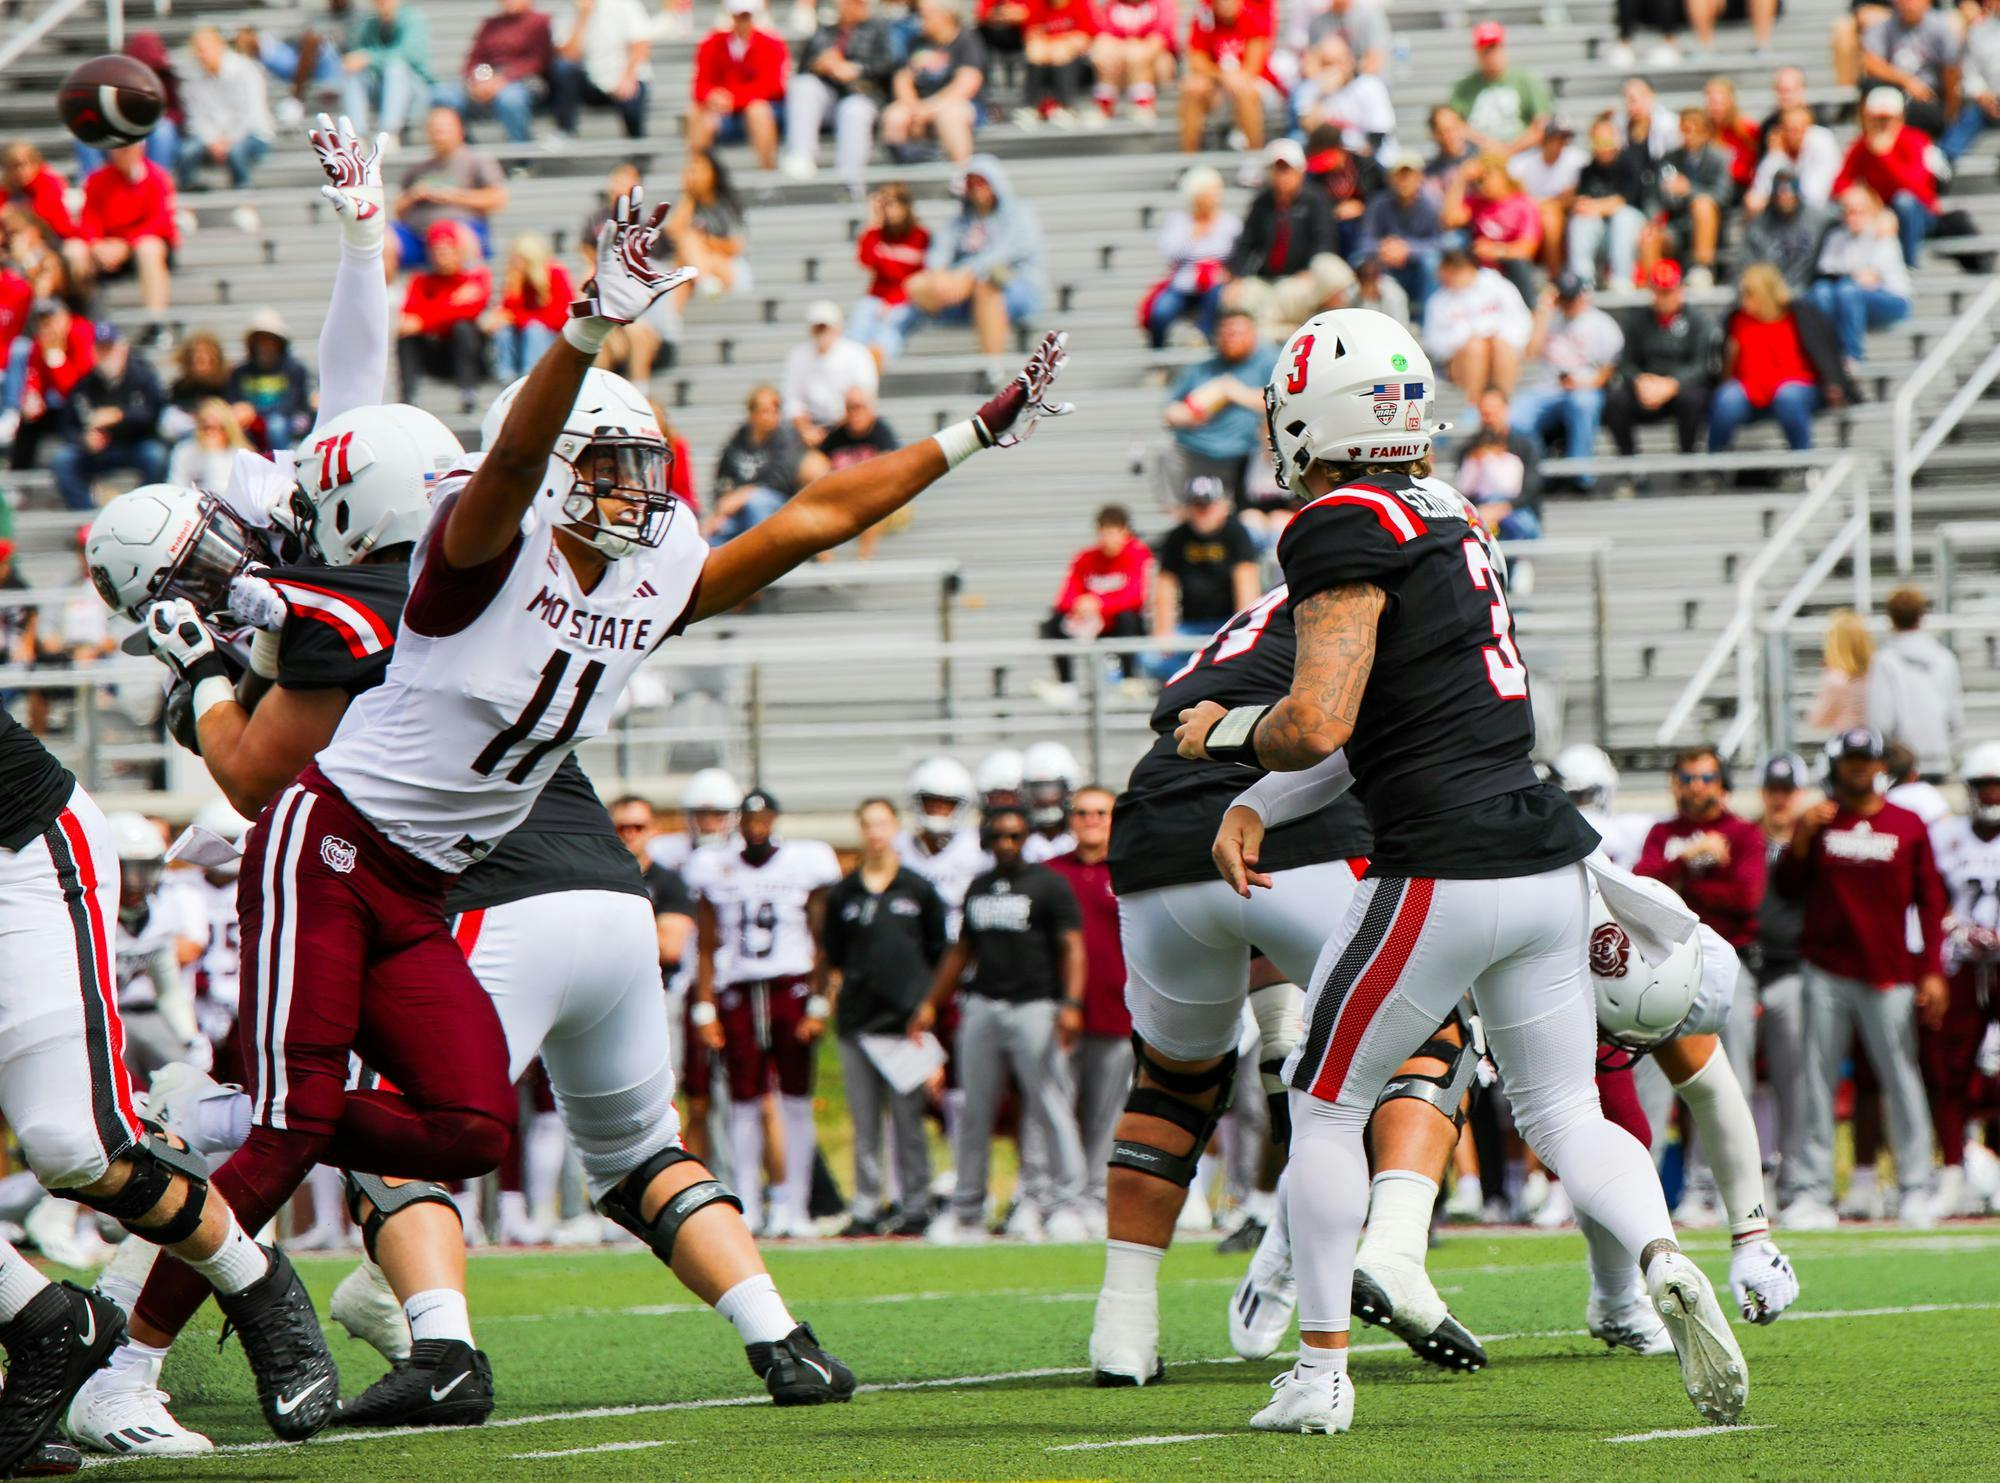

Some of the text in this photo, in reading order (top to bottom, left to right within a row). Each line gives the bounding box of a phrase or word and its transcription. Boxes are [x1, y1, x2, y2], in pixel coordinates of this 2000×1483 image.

[1287, 334, 1316, 395] 3
[314, 431, 353, 492] 71
[1370, 445, 1420, 458] FAMILY
[526, 585, 653, 650] MO STATE
[1463, 538, 1528, 700] 3
[470, 648, 607, 785] 11
